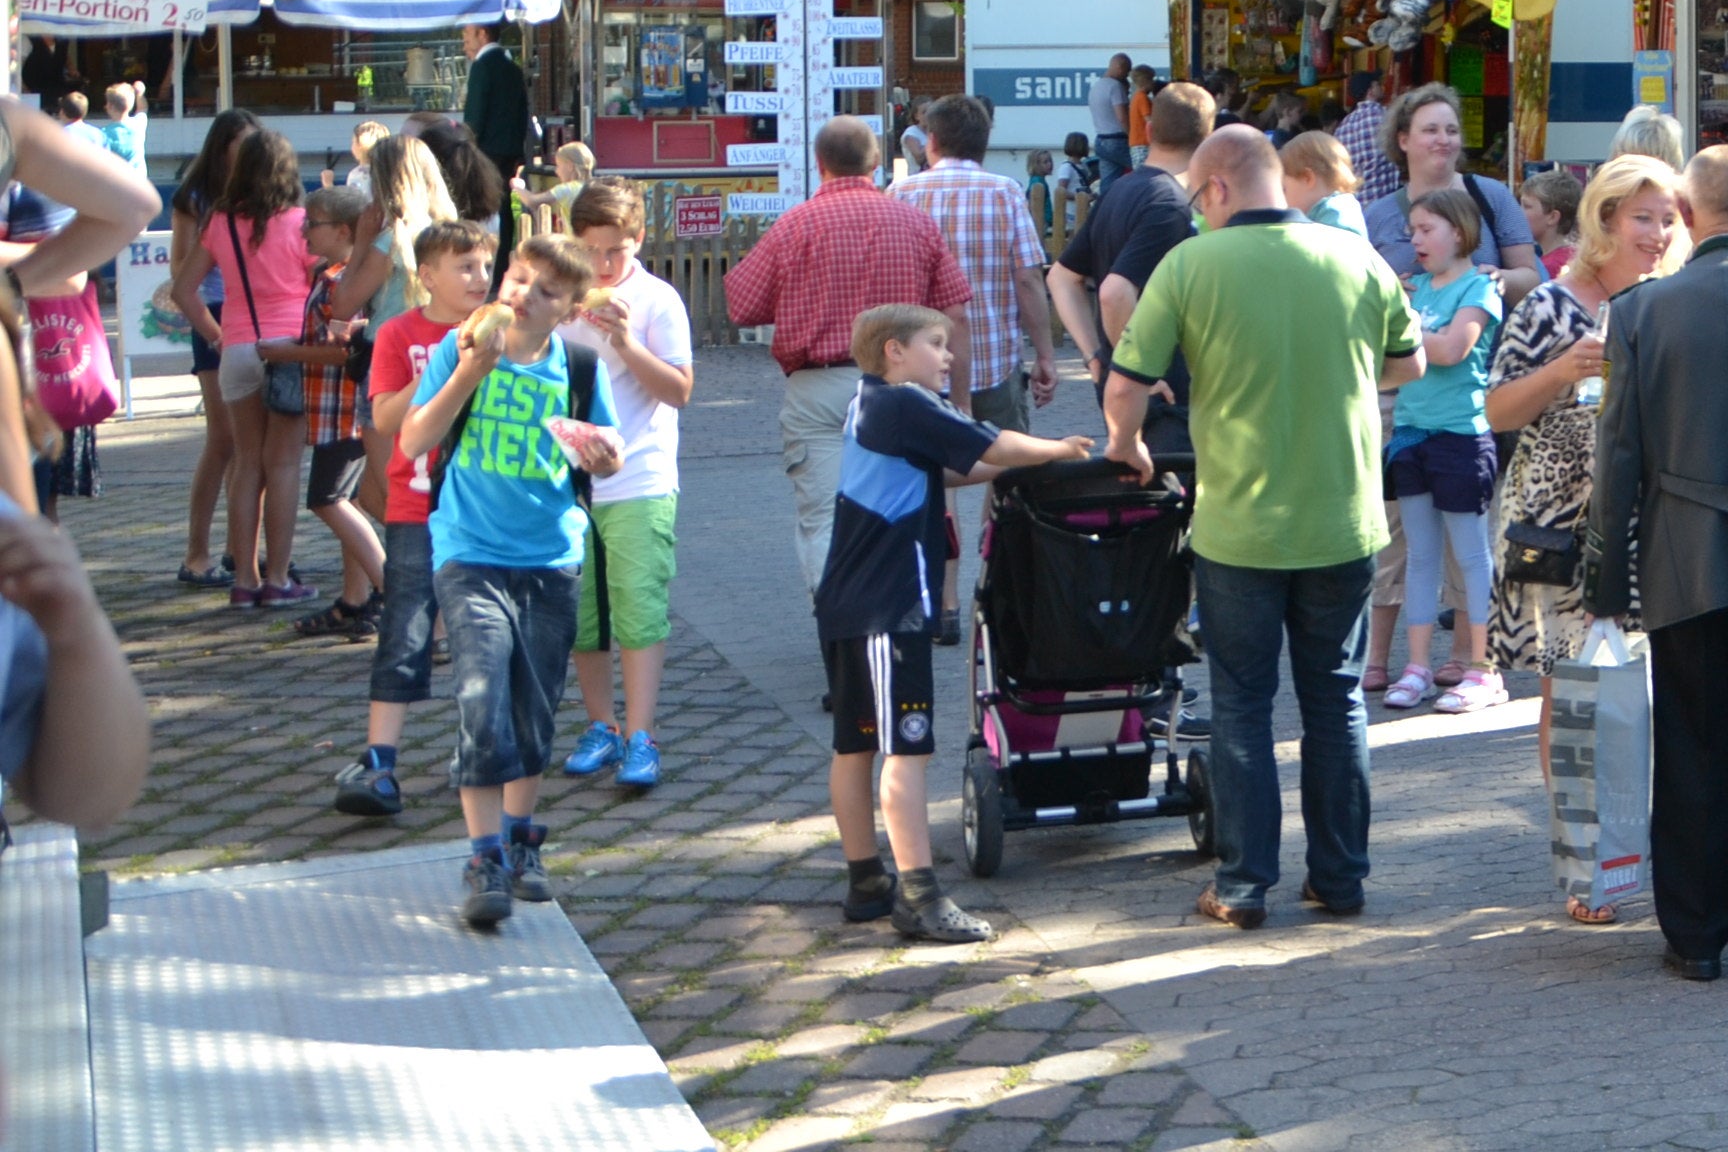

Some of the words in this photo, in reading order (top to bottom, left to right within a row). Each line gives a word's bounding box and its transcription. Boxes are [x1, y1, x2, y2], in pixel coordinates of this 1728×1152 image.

[728, 43, 783, 60] PFEIFE
[829, 70, 880, 86] AMATEUR
[729, 94, 784, 111] TUSSI
[729, 196, 785, 211] WEICHEI
